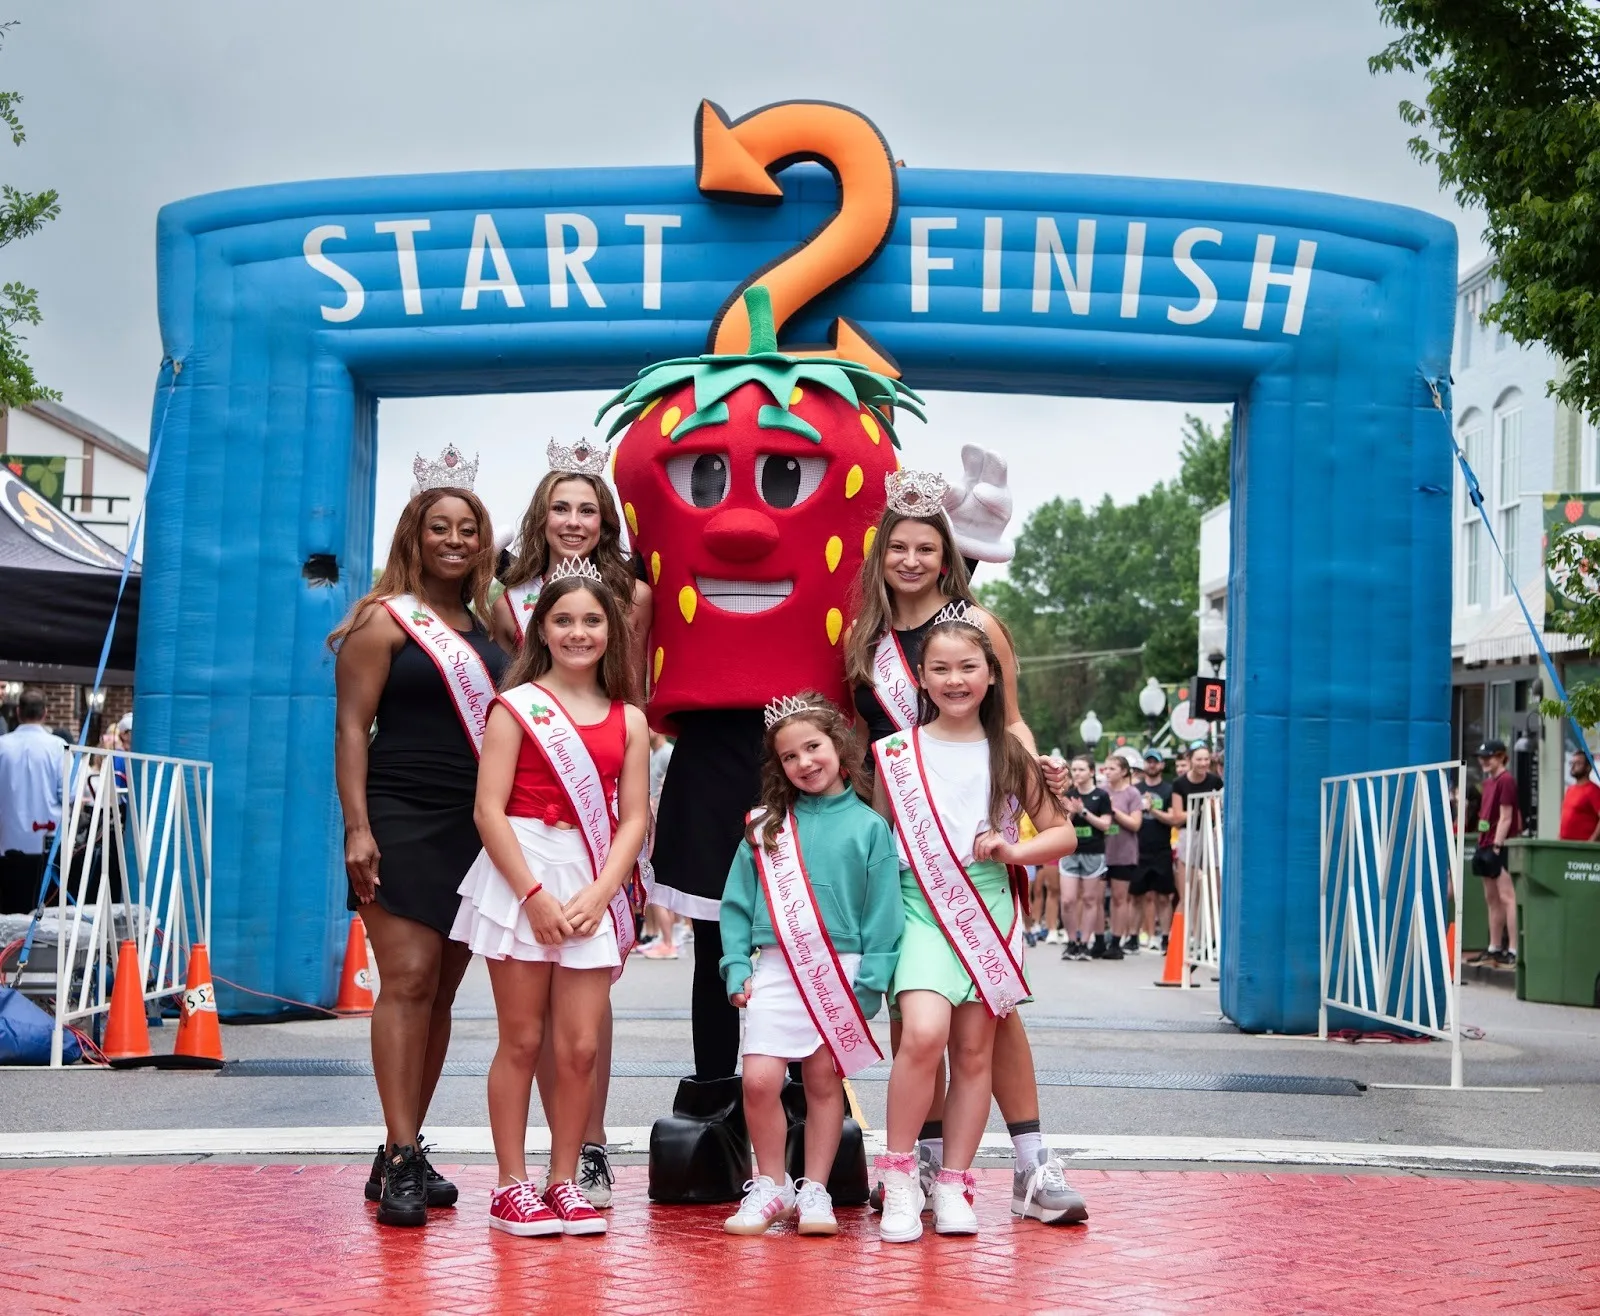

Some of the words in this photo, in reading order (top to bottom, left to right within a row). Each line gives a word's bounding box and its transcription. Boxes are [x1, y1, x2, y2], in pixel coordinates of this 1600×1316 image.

[302, 212, 682, 323] START
[910, 216, 1319, 336] FINISH
[425, 629, 453, 652] Ms.
[546, 727, 577, 775] Young
[570, 774, 595, 810] Miss
[890, 757, 912, 787] Little
[899, 787, 920, 823] Miss
[912, 818, 947, 891] Strawberry
[1567, 861, 1592, 871] TOWN
[774, 870, 797, 901] Miss
[1564, 871, 1587, 881] FORT
[941, 885, 969, 911] SC
[783, 899, 814, 967] Strawberry
[955, 907, 981, 951] Queen
[977, 948, 1009, 986] 2025
[807, 963, 845, 1023] Shortcake
[833, 1021, 863, 1053] 2025
